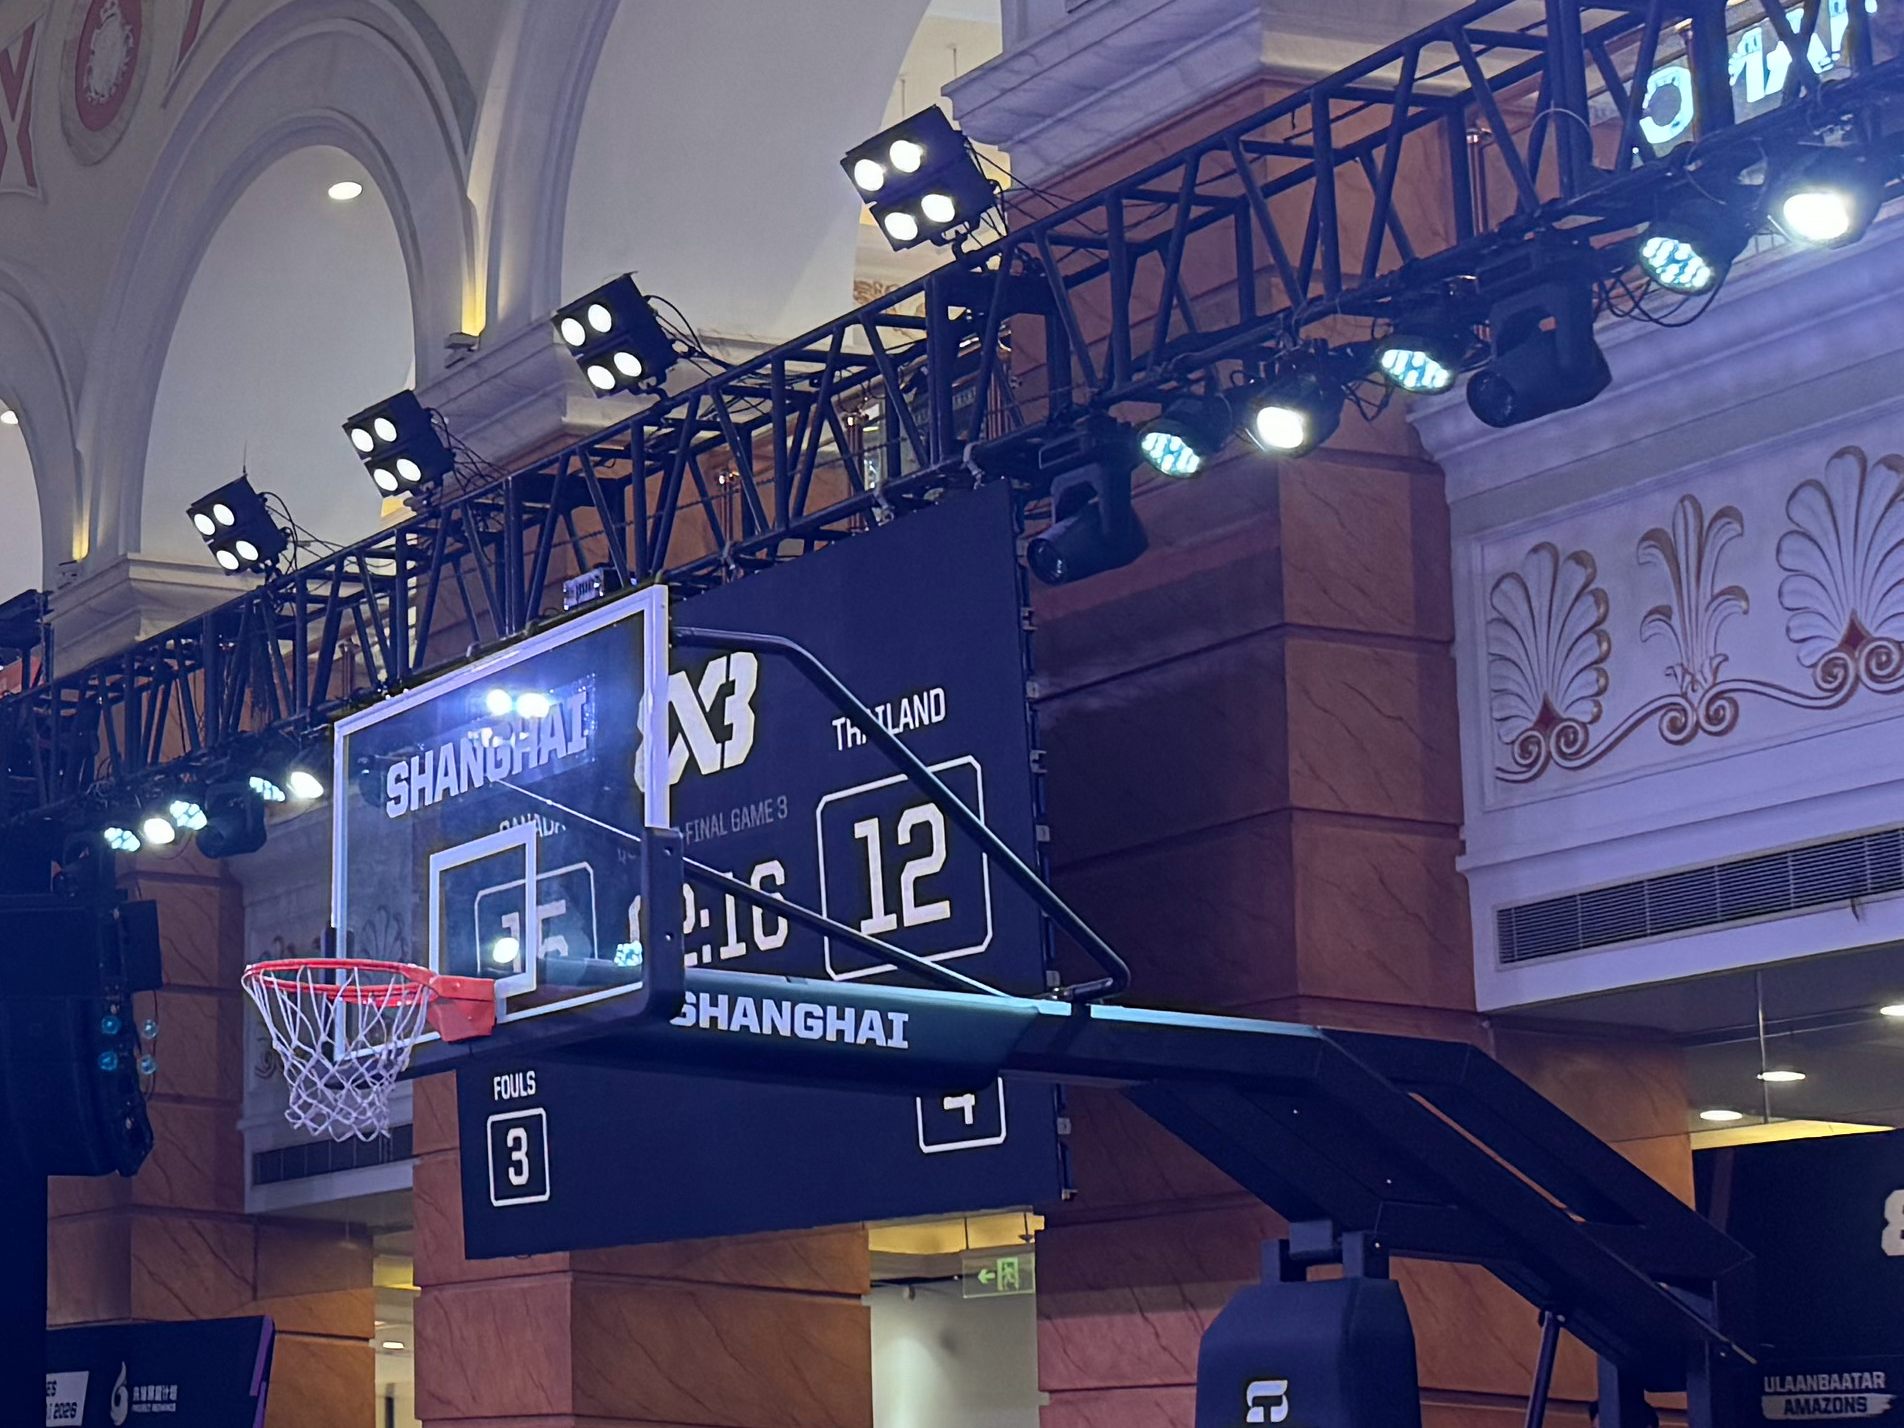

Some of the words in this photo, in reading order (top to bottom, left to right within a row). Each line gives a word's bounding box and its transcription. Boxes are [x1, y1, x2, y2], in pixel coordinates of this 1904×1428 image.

[386, 691, 587, 819] SHANGHAI
[685, 812, 727, 845] FINAL
[731, 799, 775, 832] GAME
[777, 795, 788, 820] 3
[854, 802, 951, 935] 12
[670, 991, 909, 1049] SHANGHAI
[493, 1071, 536, 1100] FOULS
[507, 1127, 529, 1186] 3
[1763, 1371, 1886, 1393] ULAANBAATAR
[1784, 1397, 1868, 1415] AMAZONS
